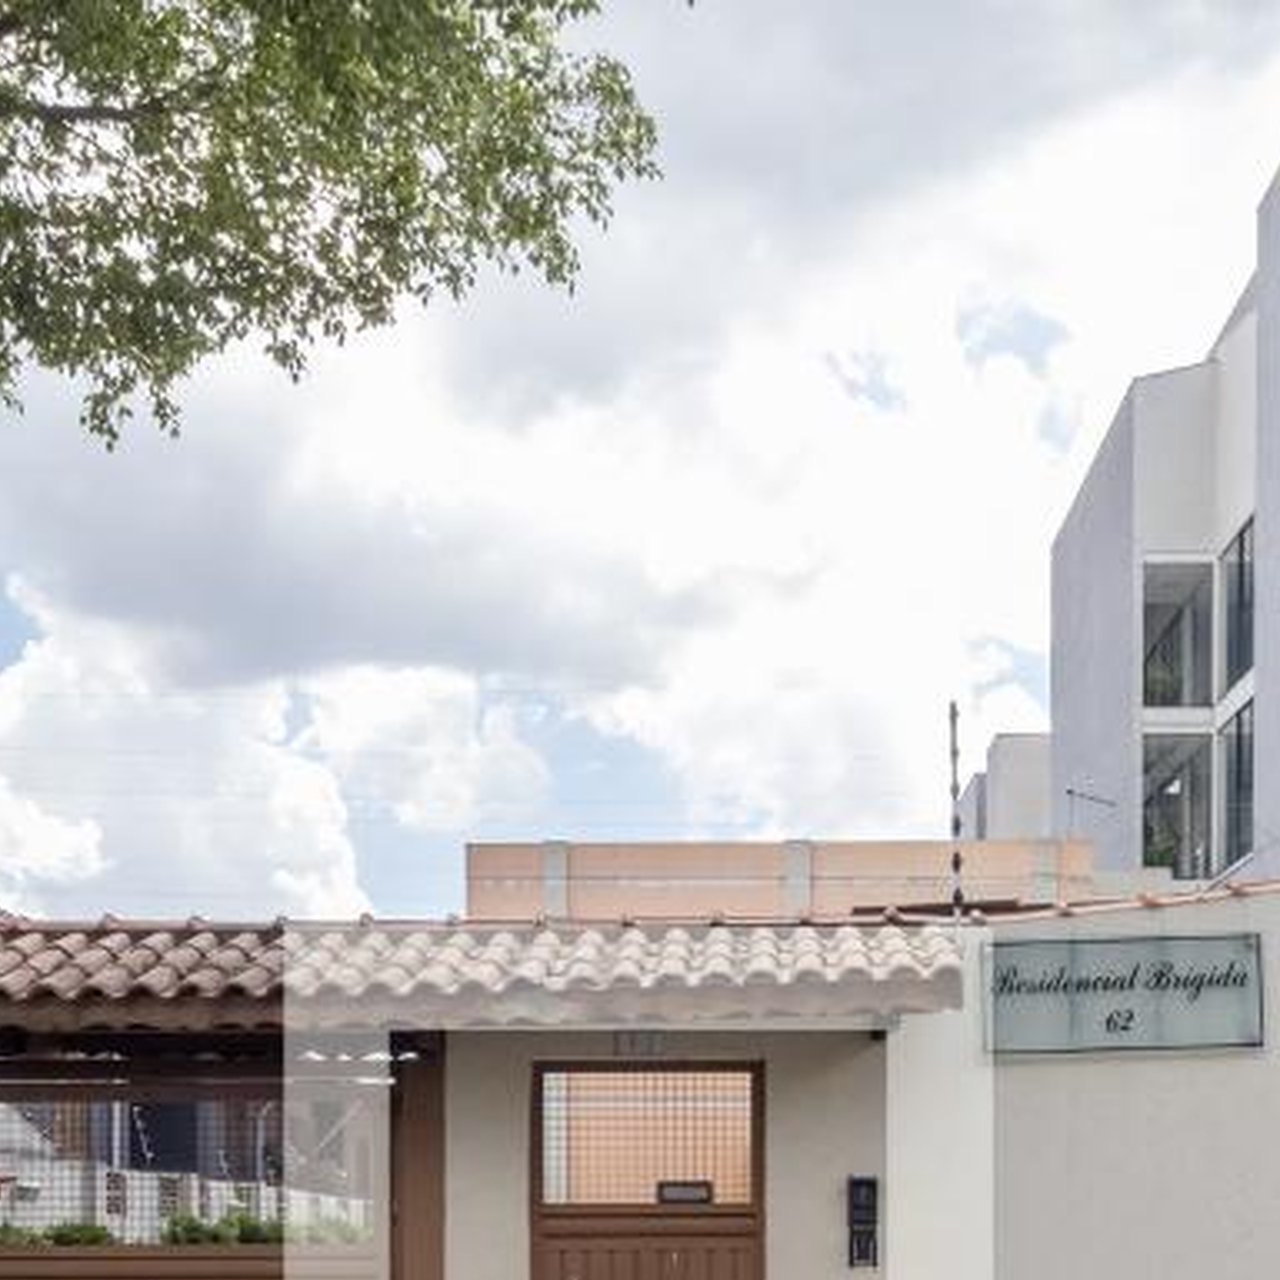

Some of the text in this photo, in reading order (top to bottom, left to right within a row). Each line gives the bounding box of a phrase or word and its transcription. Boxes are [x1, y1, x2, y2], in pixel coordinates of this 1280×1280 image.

[993, 961, 1248, 1003] Residencial Brigida
[1105, 1009, 1135, 1033] 62
